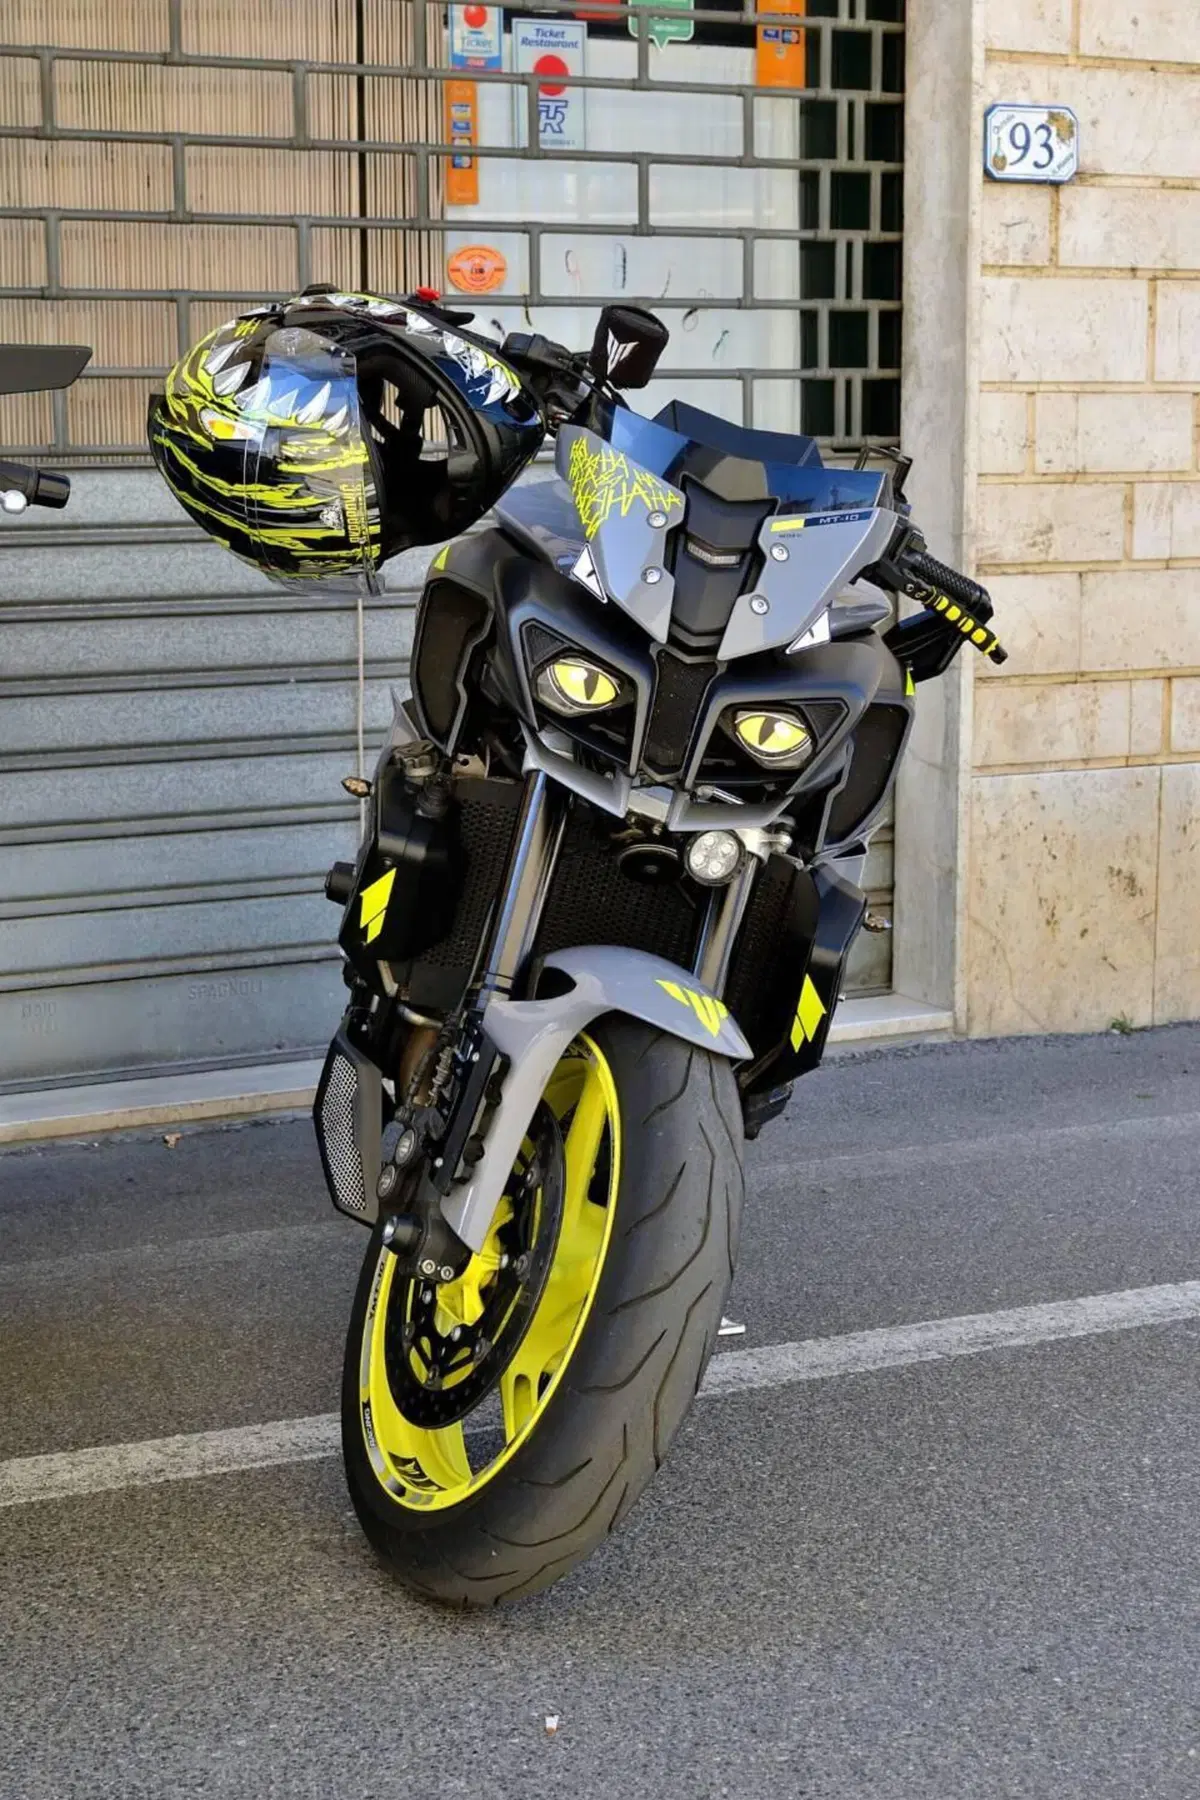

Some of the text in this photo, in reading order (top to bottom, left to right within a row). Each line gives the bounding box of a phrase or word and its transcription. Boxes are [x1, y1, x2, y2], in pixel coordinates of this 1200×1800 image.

[534, 28, 566, 39] Ticket
[520, 37, 579, 49] Restaurant
[1009, 121, 1054, 169] 93
[818, 513, 861, 525] MT-10
